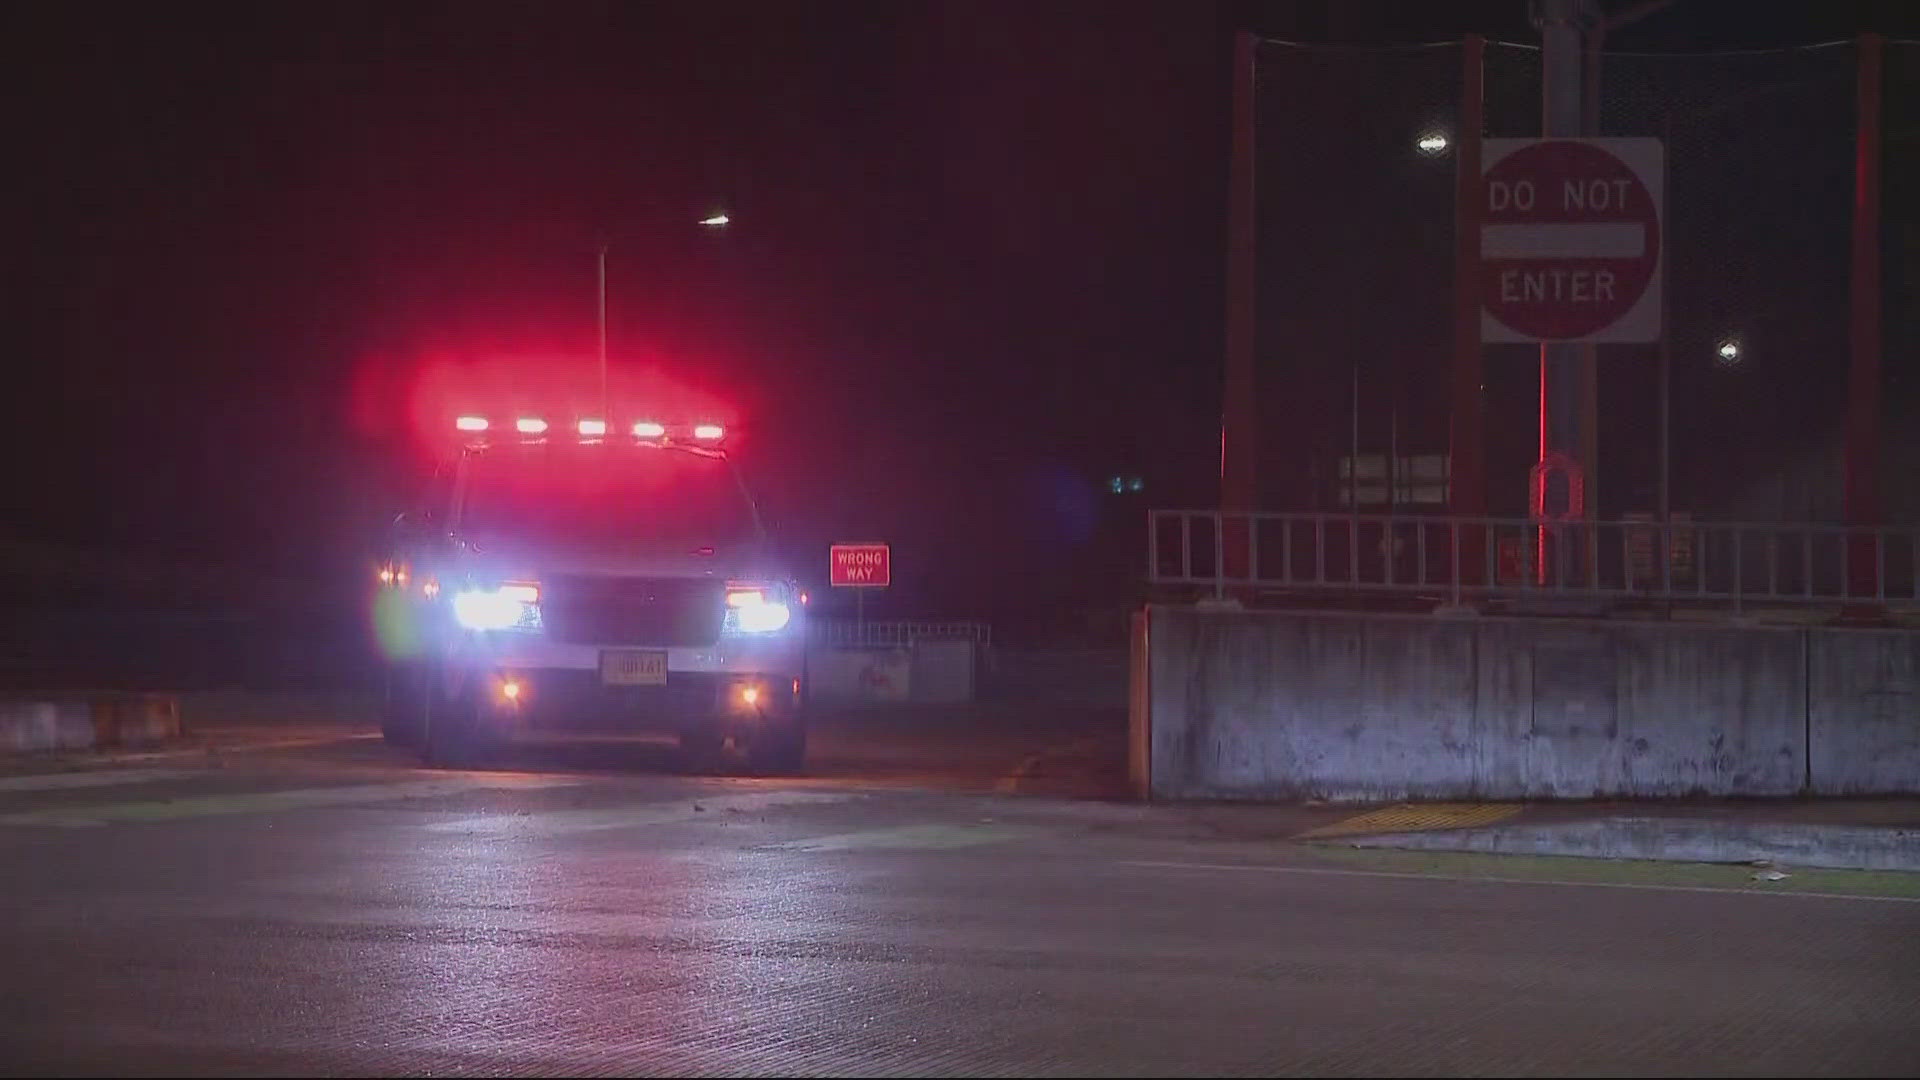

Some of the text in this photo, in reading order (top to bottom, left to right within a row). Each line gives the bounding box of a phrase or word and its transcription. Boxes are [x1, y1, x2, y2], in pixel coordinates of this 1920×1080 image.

[1489, 180, 1632, 211] DO NOT
[1501, 270, 1615, 302] ENTER
[838, 551, 882, 564] WRONG
[847, 566, 873, 580] WAY
